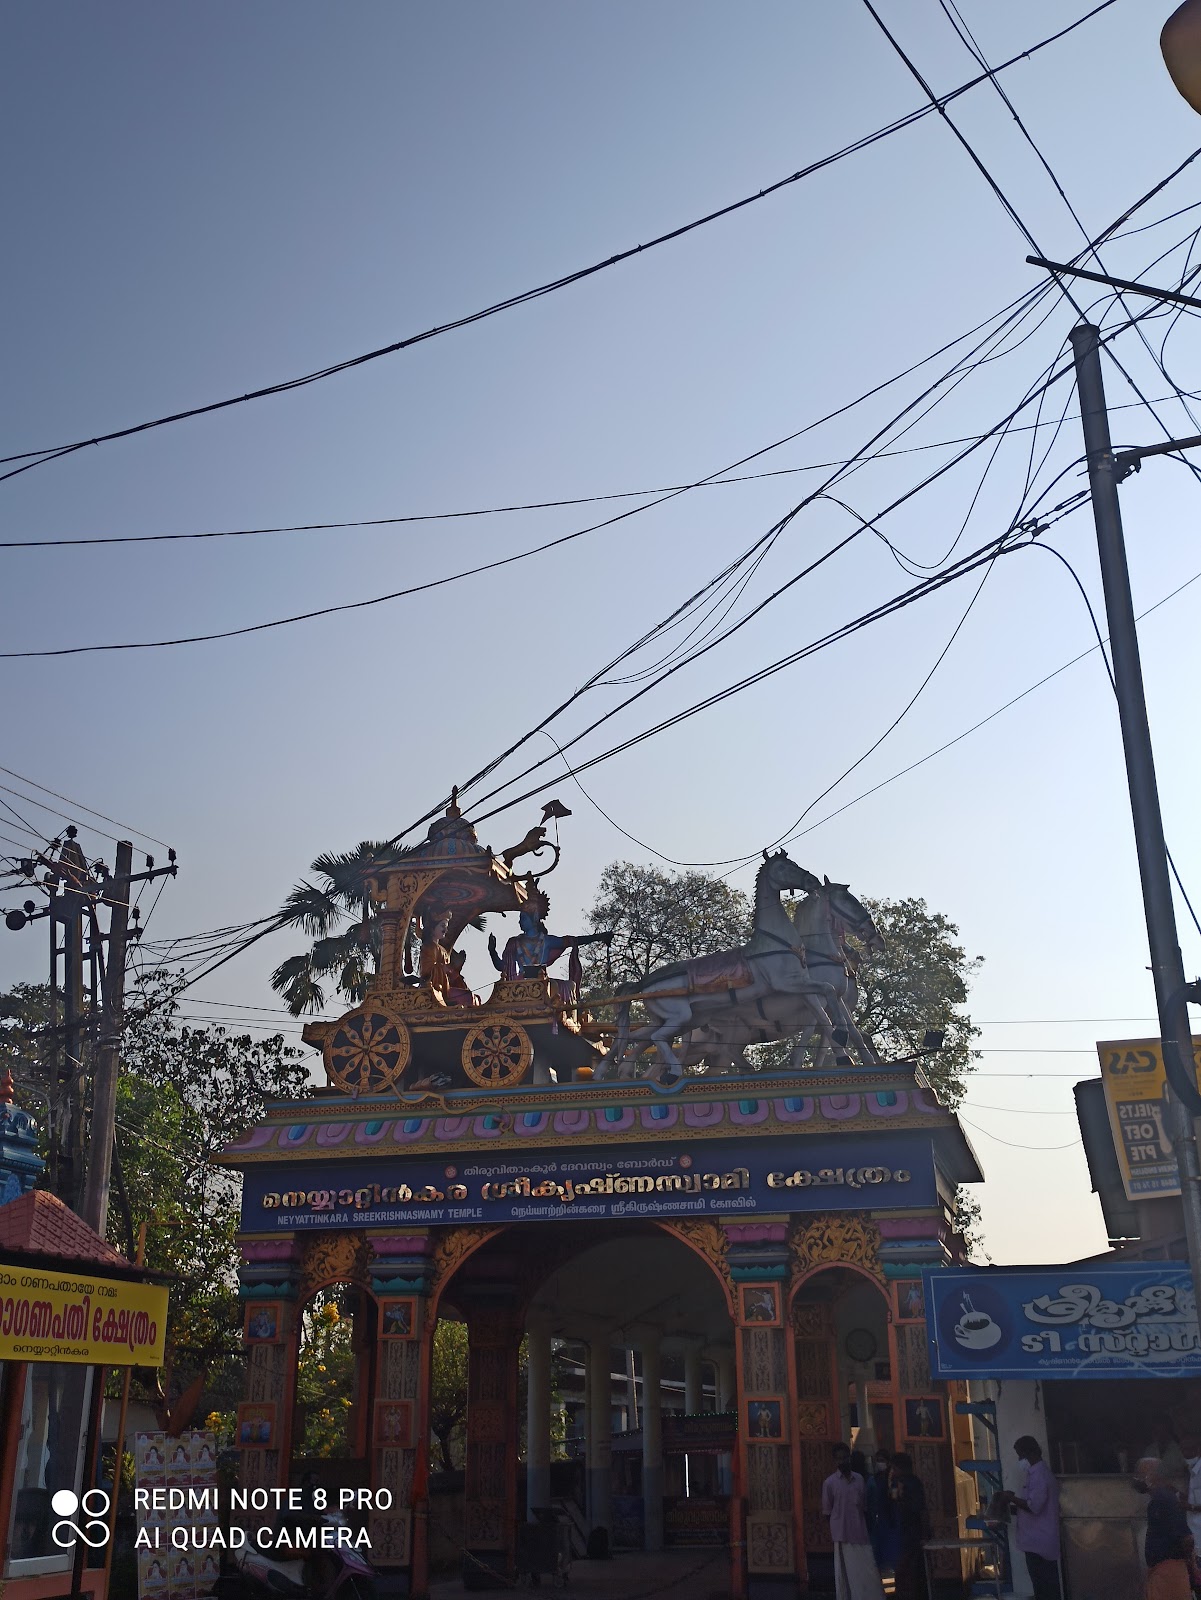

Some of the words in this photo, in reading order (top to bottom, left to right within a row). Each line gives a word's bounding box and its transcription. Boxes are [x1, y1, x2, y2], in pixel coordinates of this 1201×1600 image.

[766, 1166, 911, 1189] ക്ഷേത്രം
[710, 1196, 757, 1209] கோவில்
[277, 1213, 349, 1226] NEYYATTINKARA
[352, 1209, 444, 1223] SREEKRISHNASWAMY
[447, 1207, 483, 1219] TEMPLE
[0, 1295, 90, 1341] ാഗണപതി
[92, 1306, 157, 1353] ക്ഷേത്രം
